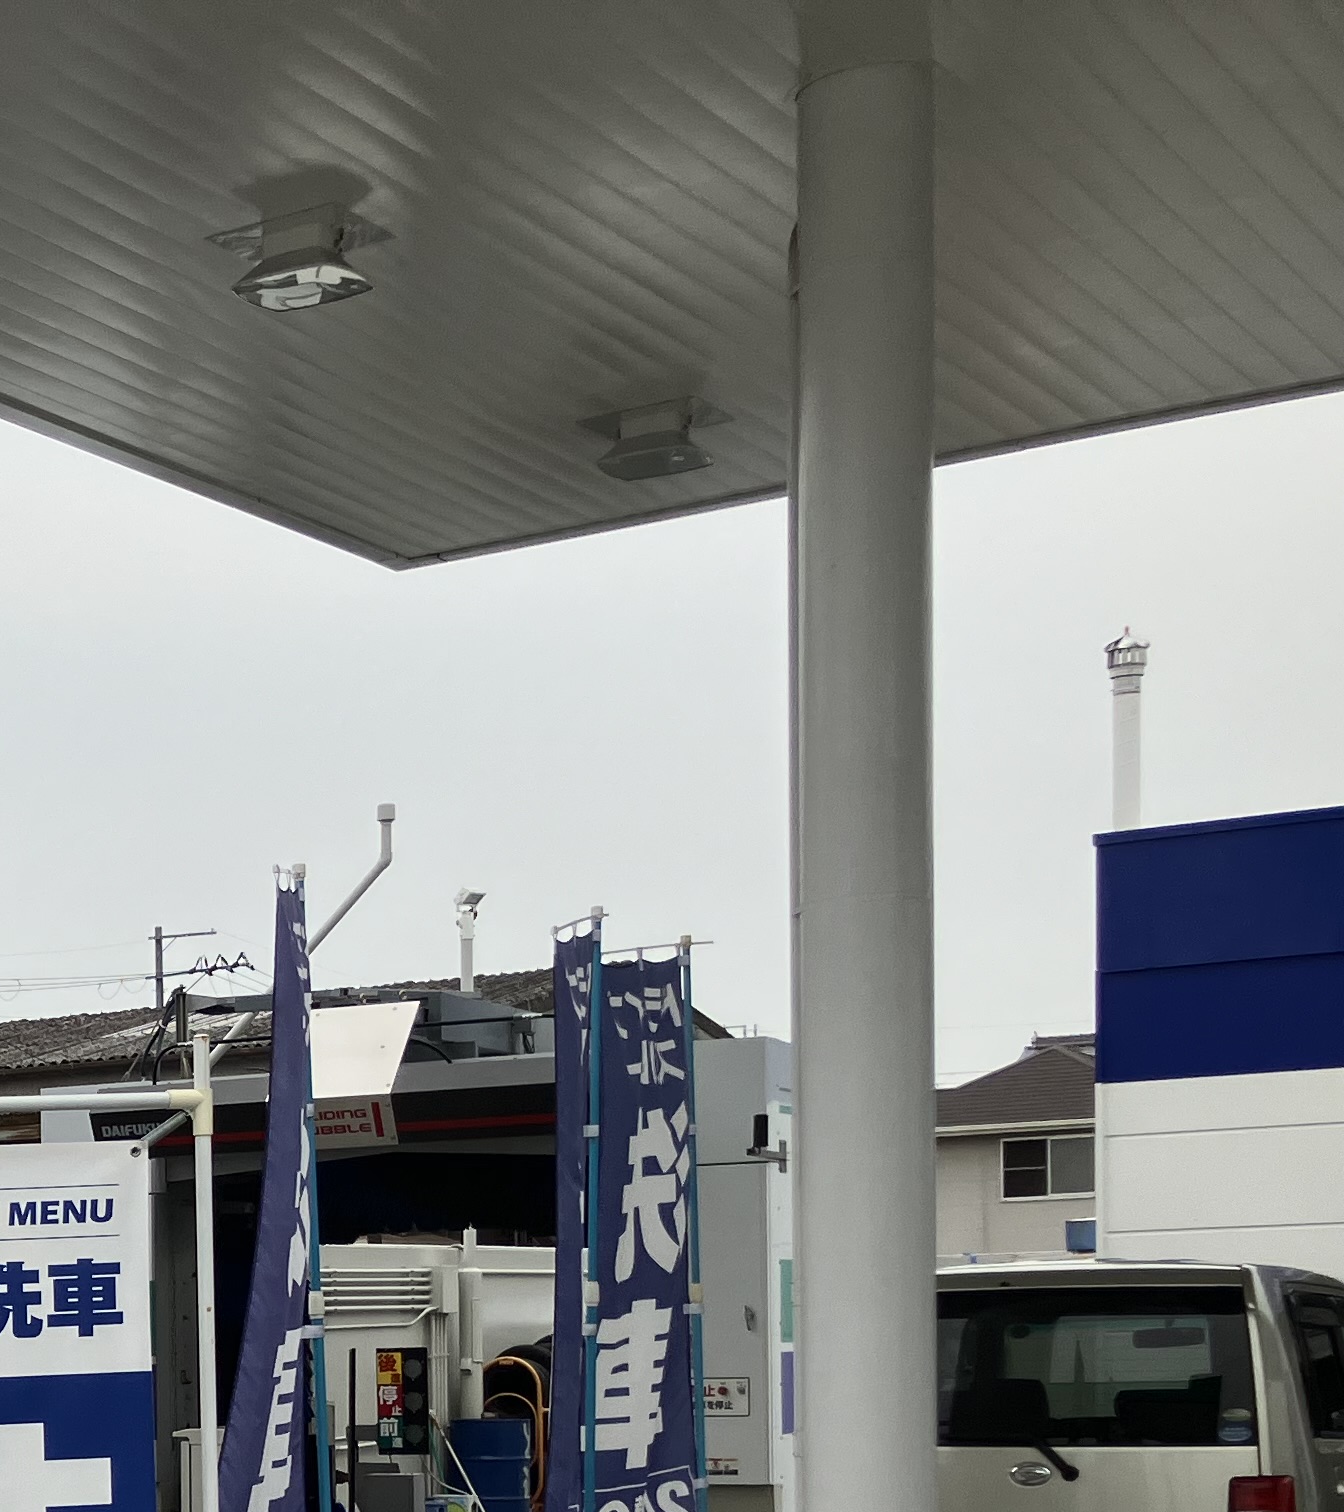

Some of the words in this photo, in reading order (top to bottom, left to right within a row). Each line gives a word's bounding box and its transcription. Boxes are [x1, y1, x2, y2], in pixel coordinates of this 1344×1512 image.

[314, 1109, 367, 1121] IDING
[101, 1123, 162, 1138] DAIFUK
[8, 1197, 113, 1226] MENU
